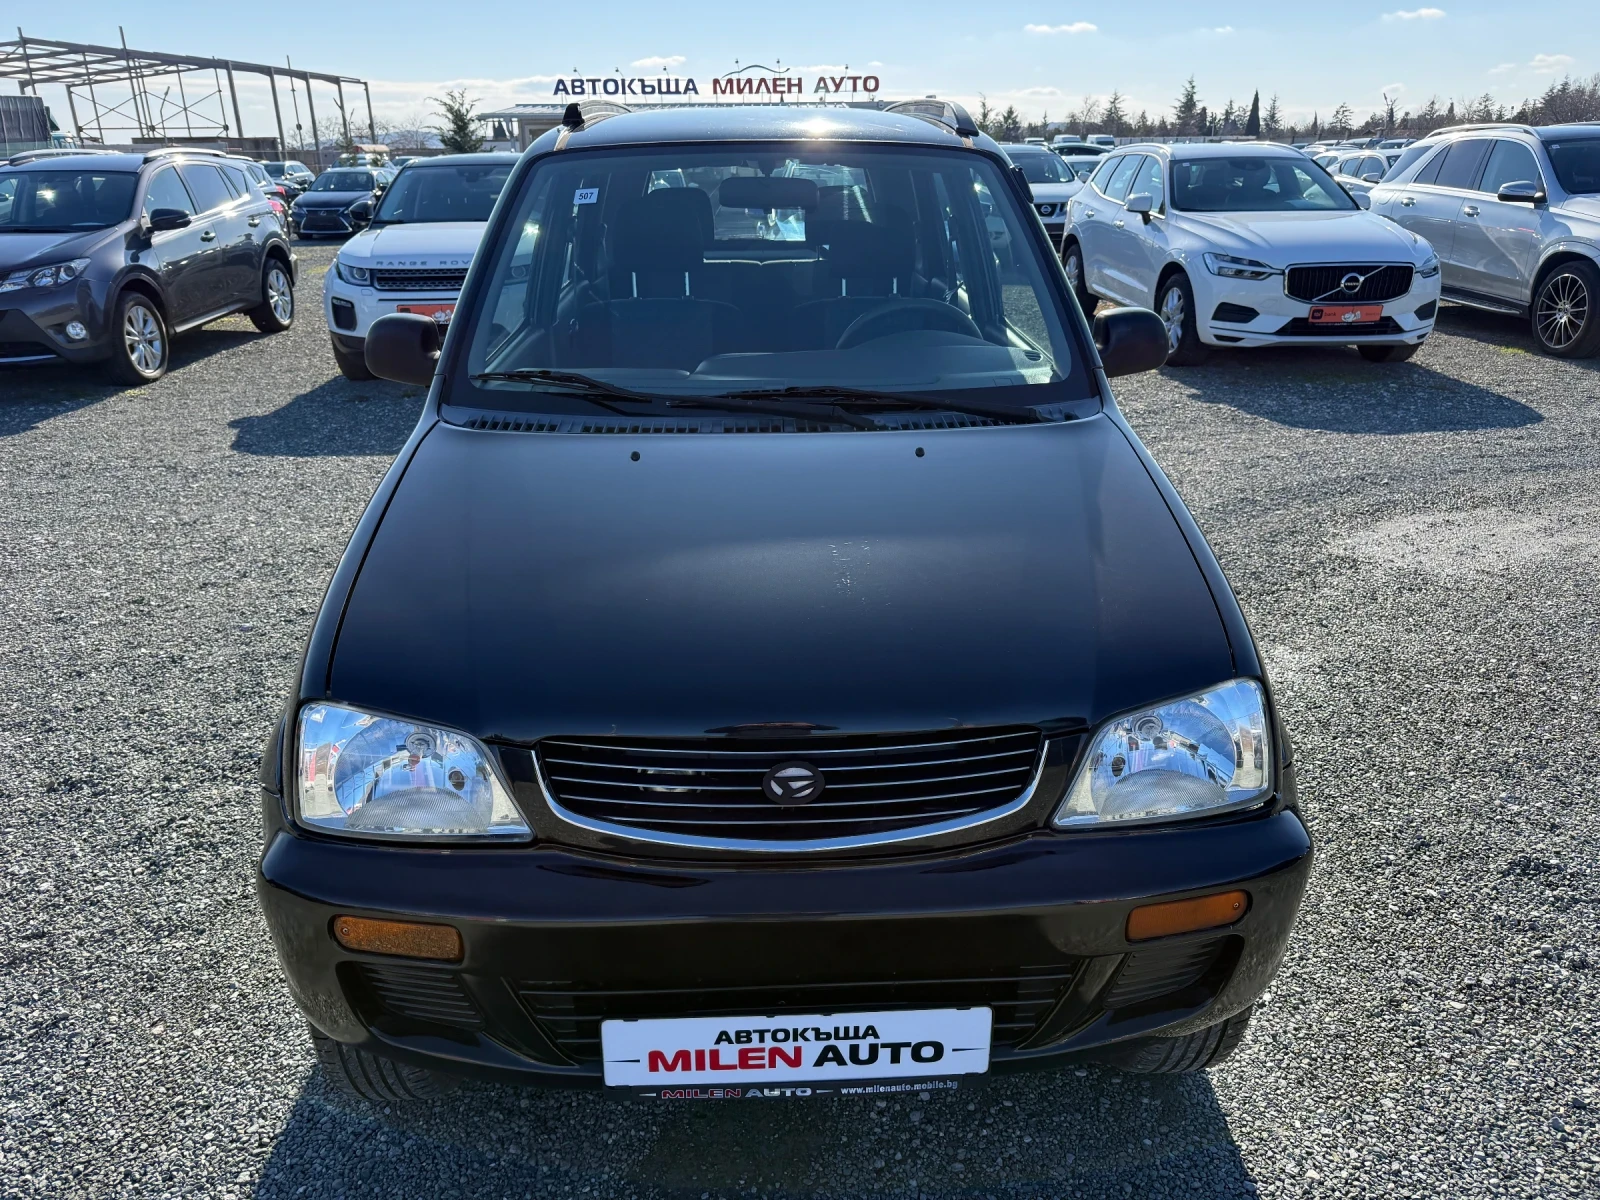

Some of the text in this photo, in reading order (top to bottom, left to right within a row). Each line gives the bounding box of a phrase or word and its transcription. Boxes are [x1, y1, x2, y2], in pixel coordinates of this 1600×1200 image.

[553, 76, 880, 95] АВТОКЪША МИЛЕН АУТО
[578, 192, 594, 200] 507
[714, 1025, 880, 1045] АВТОКЪША
[648, 1041, 944, 1072] MILEN AUTO
[661, 1087, 812, 1099] MILEN AUTO
[840, 1080, 958, 1094] www.milenauto.mobile.bg
